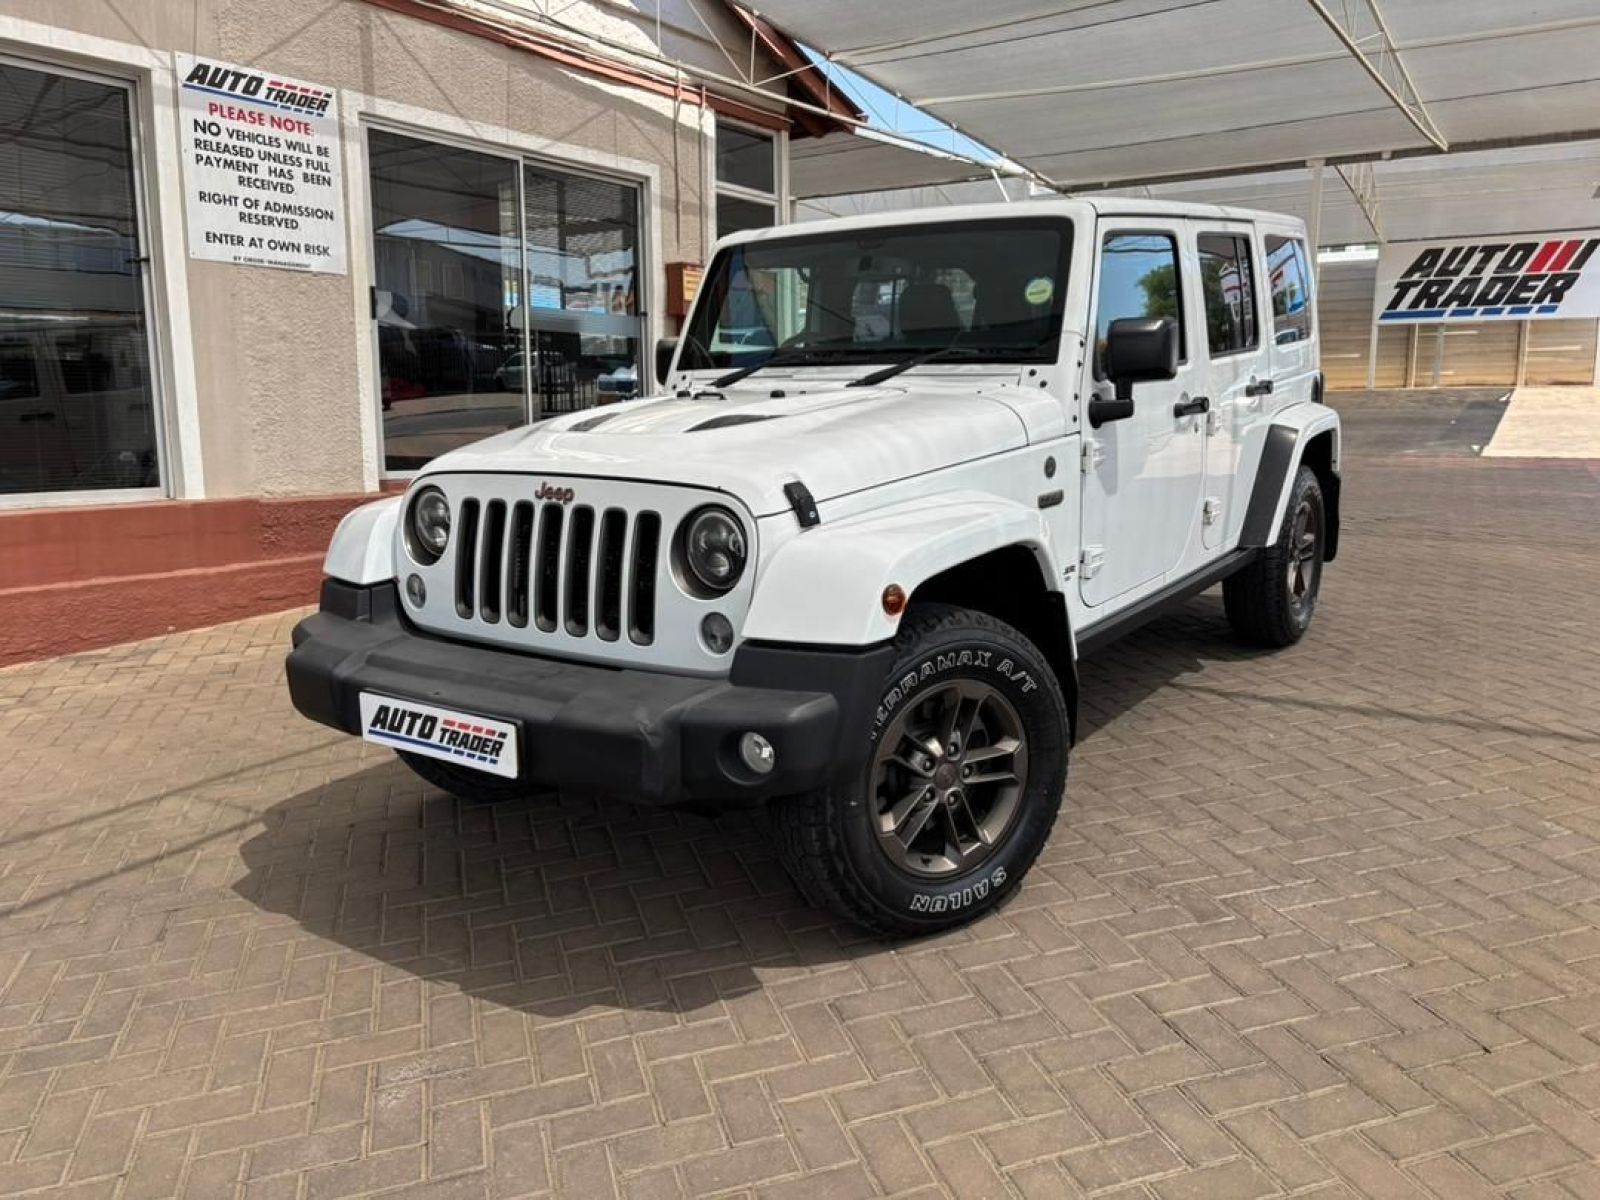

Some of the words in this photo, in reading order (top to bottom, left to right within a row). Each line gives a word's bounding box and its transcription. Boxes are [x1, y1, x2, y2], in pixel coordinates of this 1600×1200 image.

[185, 63, 265, 97] AUTO
[265, 87, 330, 112] TRADER
[208, 102, 265, 126] PLEASE
[193, 118, 221, 137] NO
[225, 128, 281, 149] VEHICLES
[285, 139, 313, 155] WILL
[316, 145, 330, 158] BE
[194, 138, 254, 159] RELEASED
[258, 150, 302, 168] UNLESS
[305, 159, 331, 173] FULL
[195, 153, 259, 175] PAYMENT
[268, 165, 294, 180] HAS
[302, 172, 332, 187] BEEN
[199, 191, 239, 207] RIGHT
[242, 197, 260, 210] OF
[264, 200, 334, 221] ADMISSION
[205, 231, 244, 247] ENTER
[248, 236, 265, 249] AT
[267, 239, 300, 253] OWN
[304, 243, 331, 257] RISK
[1400, 242, 1540, 279] AUTO
[1385, 272, 1581, 310] TRADER
[534, 481, 575, 506] Jeep
[997, 658, 1038, 692] A/T
[370, 704, 438, 740] AUTO
[438, 727, 505, 758] TRADER
[909, 866, 1008, 912] SAILUN
